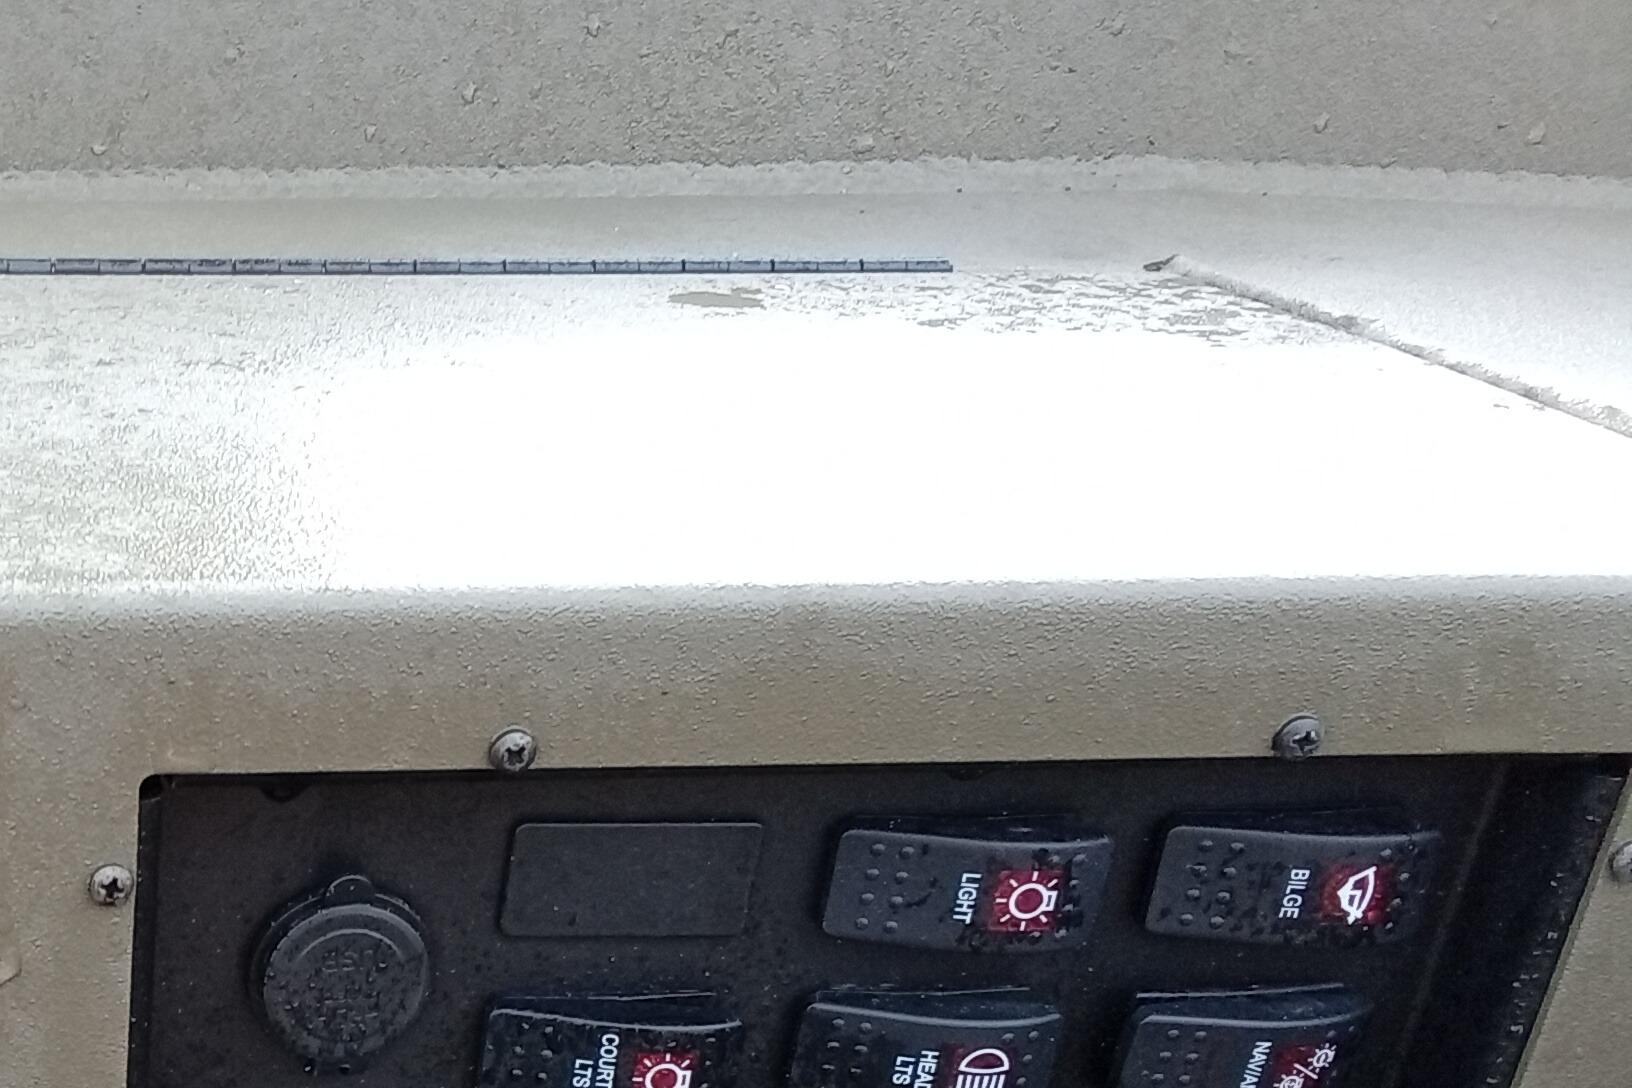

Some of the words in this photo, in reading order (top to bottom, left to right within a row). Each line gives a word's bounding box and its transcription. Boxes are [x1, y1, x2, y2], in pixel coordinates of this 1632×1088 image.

[952, 872, 983, 925] LIGHT
[1278, 869, 1311, 919] BILGE
[572, 1058, 594, 1088] LTS
[892, 1056, 916, 1085] LTS
